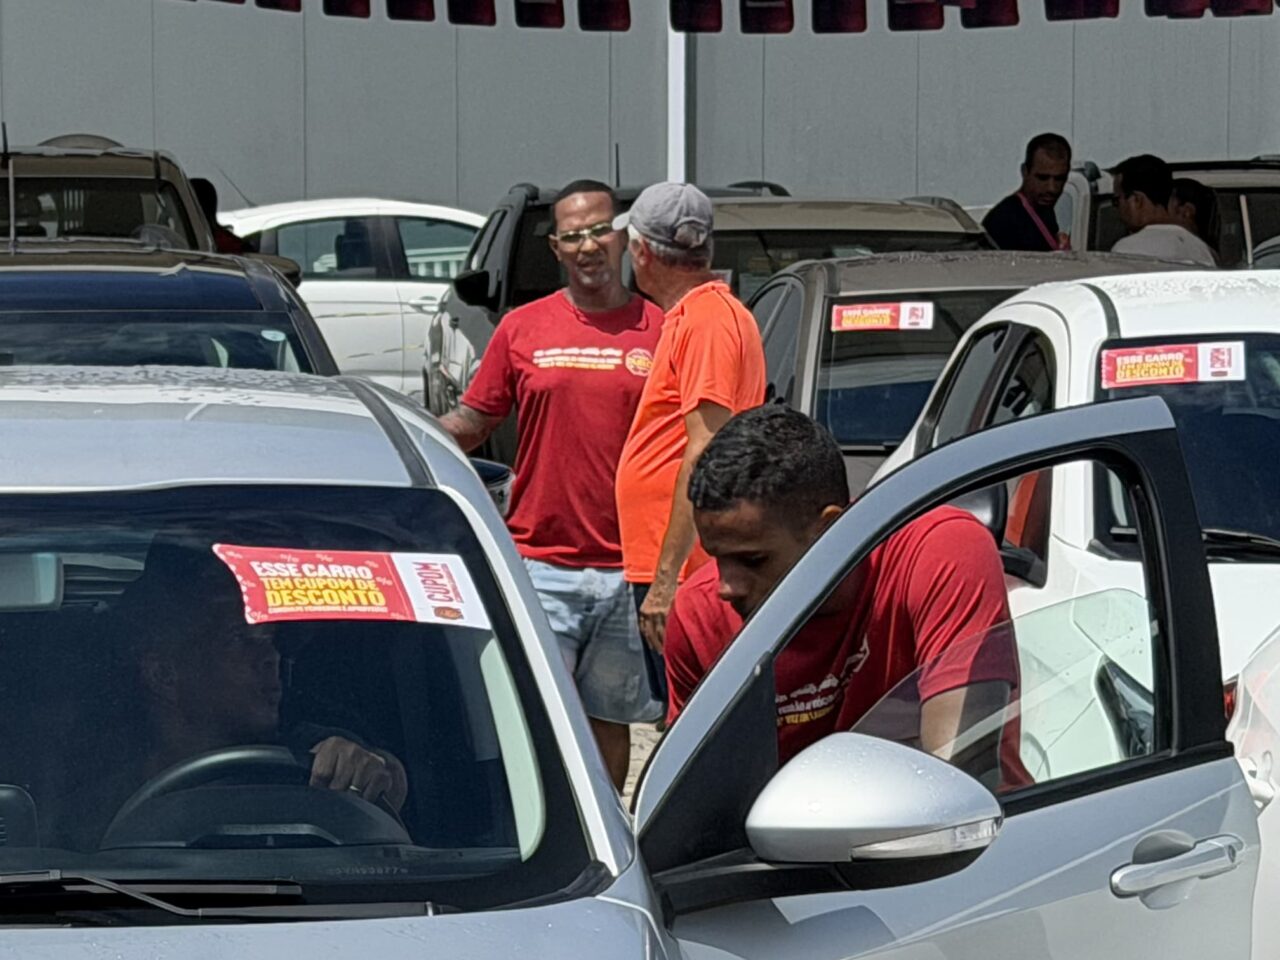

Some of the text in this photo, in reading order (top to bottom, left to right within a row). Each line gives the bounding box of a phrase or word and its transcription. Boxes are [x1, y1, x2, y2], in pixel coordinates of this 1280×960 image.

[250, 561, 373, 580] ESSE CARRO
[263, 577, 379, 592] TEM CUPOM DE
[412, 561, 454, 604] CUPOM
[267, 589, 386, 608] DESCONTO
